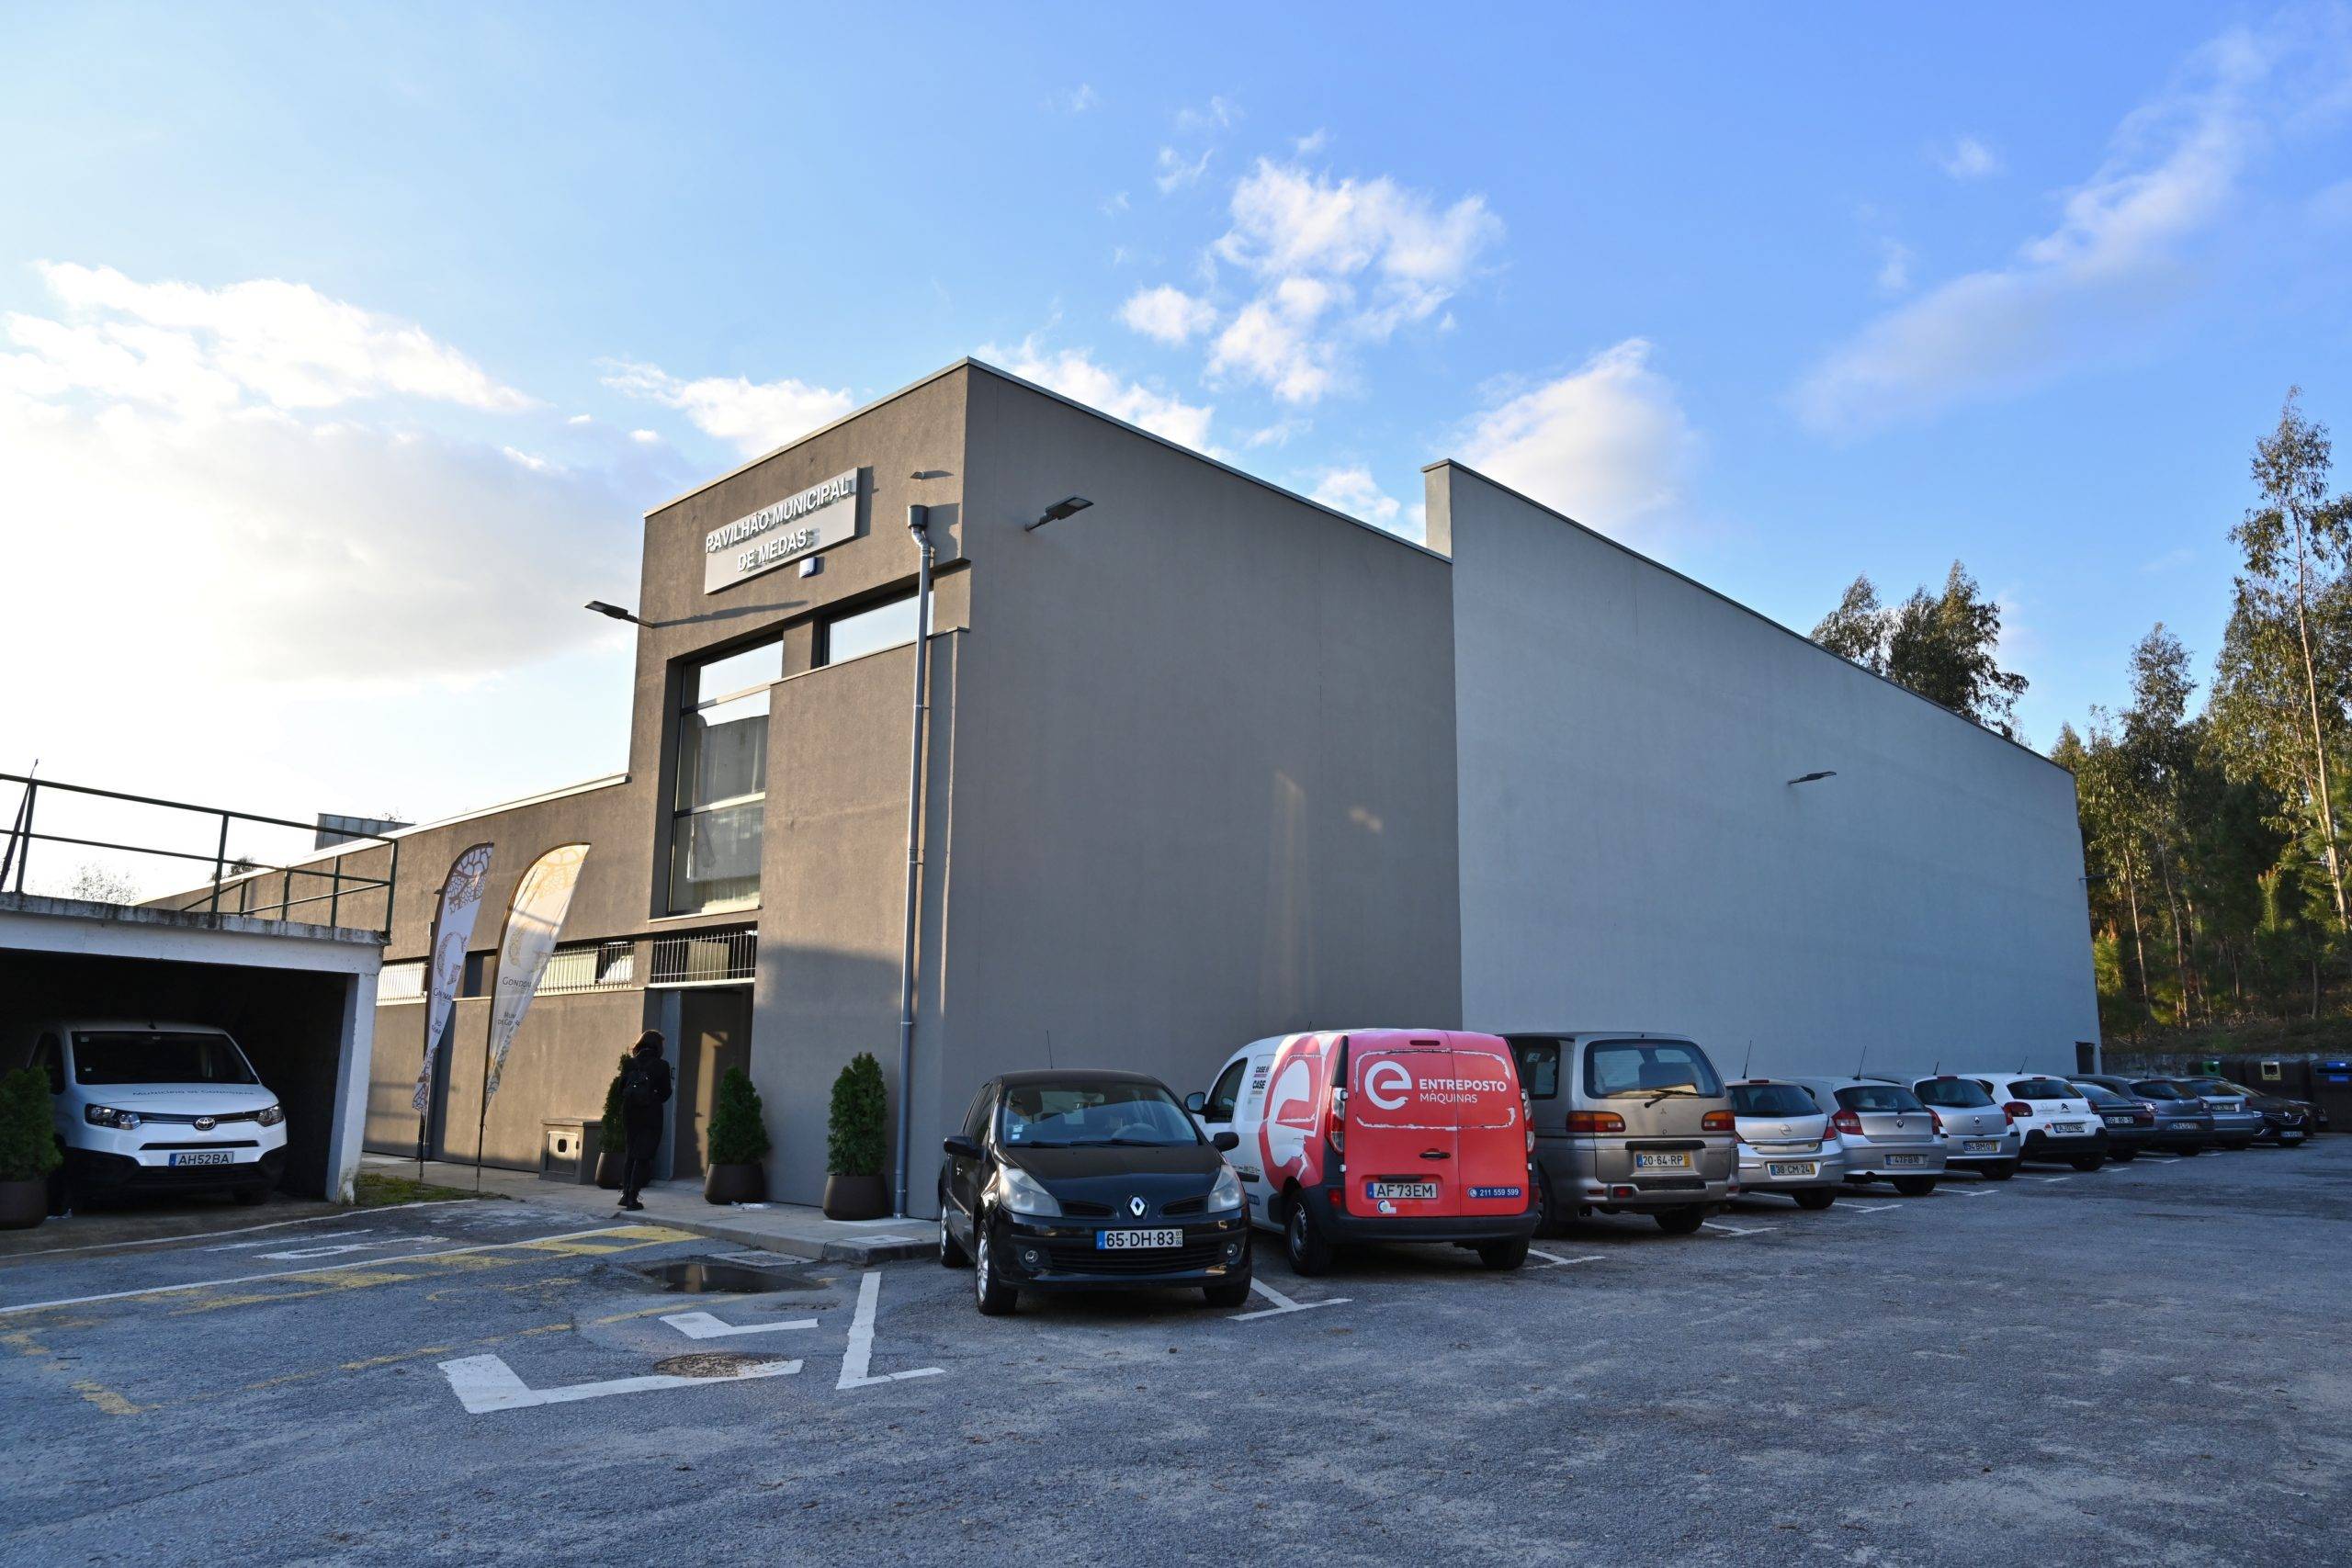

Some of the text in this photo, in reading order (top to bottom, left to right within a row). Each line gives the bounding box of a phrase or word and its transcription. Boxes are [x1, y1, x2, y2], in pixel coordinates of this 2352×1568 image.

[705, 477, 849, 553] PAVILHÃO MUNICIPAL
[737, 528, 808, 572] DE MEDAS
[1419, 1078, 1507, 1092] ENTREPOSTO
[1419, 1090, 1478, 1104] MÁQUINAS
[177, 1154, 230, 1165] AH52BA
[1479, 1189, 1491, 1197] 211
[1507, 1188, 1519, 1196] 599
